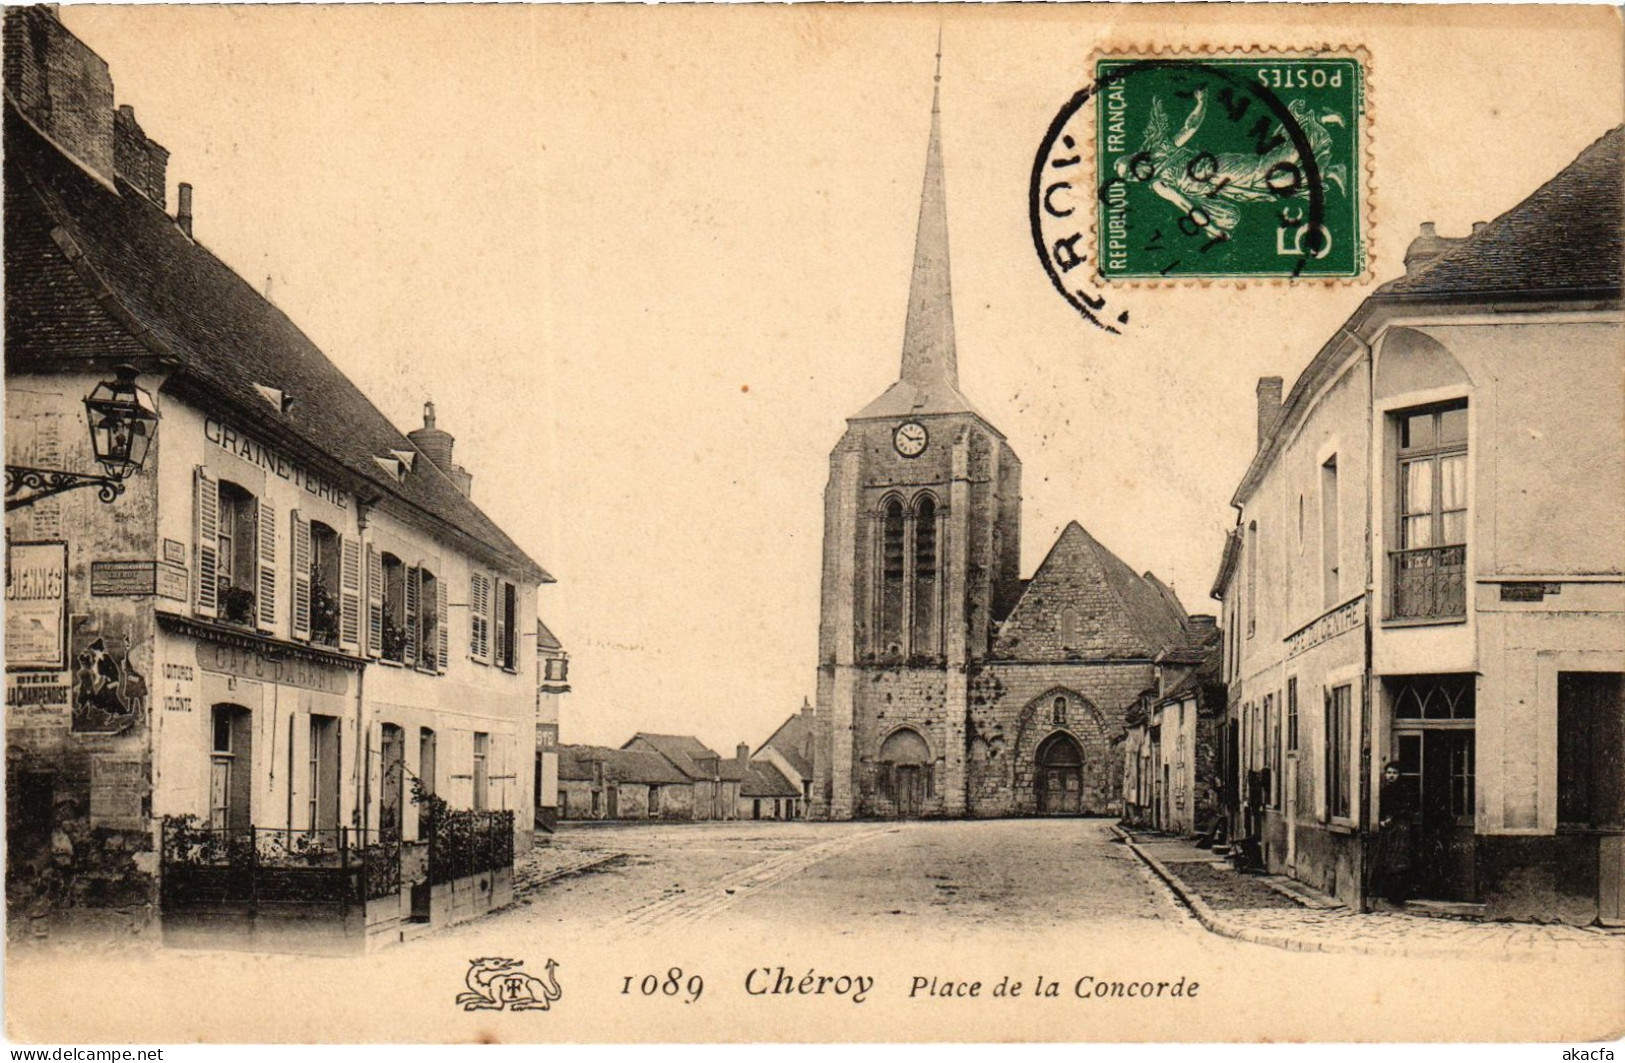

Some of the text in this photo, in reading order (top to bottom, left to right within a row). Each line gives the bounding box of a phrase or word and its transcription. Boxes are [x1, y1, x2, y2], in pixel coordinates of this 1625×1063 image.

[1257, 68, 1342, 88] POSTES
[204, 416, 348, 510] GRAINETERIE
[1321, 601, 1360, 639] CENTRE
[620, 966, 1200, 1005] 1089 Chéroy Place de la Concorde
